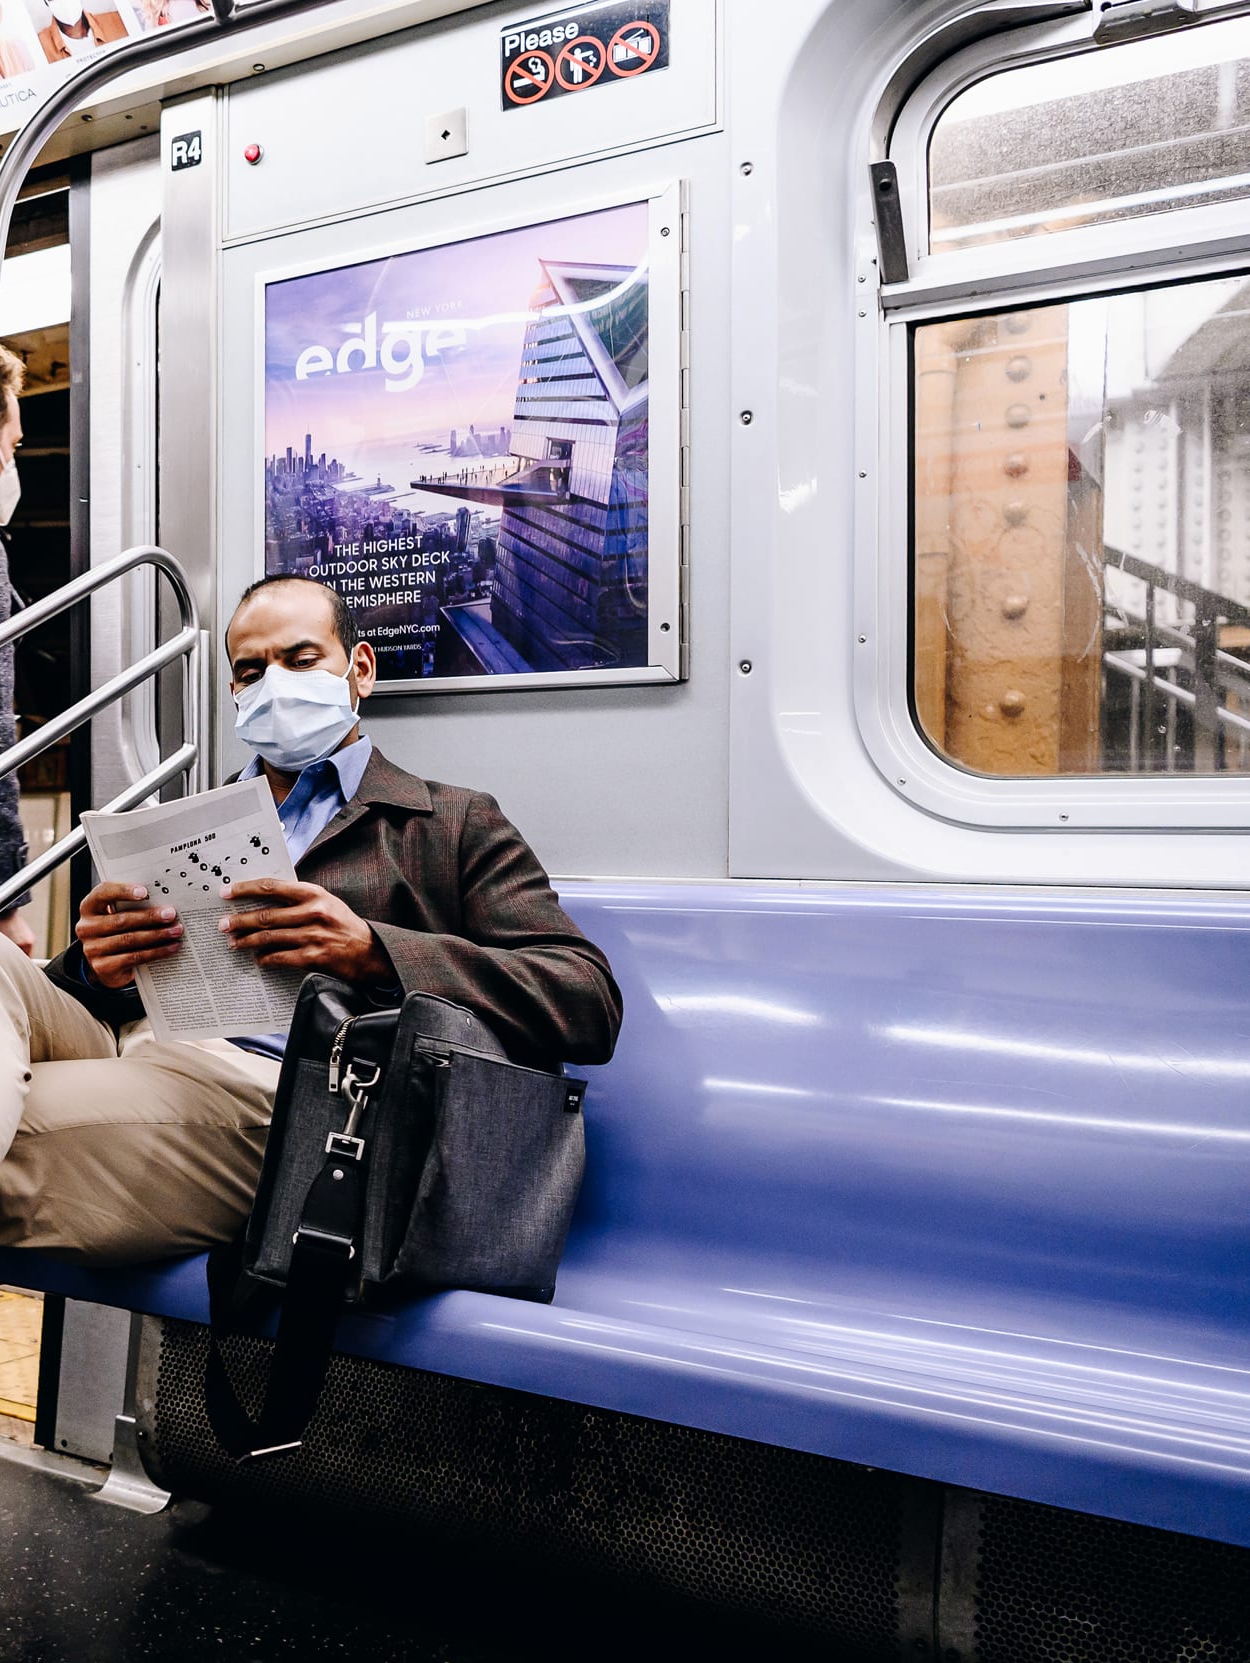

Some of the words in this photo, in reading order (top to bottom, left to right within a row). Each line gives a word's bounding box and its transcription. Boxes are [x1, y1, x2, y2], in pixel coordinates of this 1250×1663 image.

[504, 22, 580, 58] Please
[172, 136, 201, 167] R4
[406, 306, 431, 320] NEW
[435, 300, 464, 313] YORK
[295, 310, 467, 393] edge
[334, 542, 360, 557] THE
[363, 535, 423, 553] HIGHEST
[309, 558, 378, 576] OUTDOOR
[381, 555, 408, 571] SKY
[411, 550, 451, 567] DECK
[340, 577, 366, 592] THE
[368, 570, 437, 589] WESTERN
[343, 590, 422, 609] EMISPHERE
[366, 628, 376, 637] at
[377, 623, 441, 638] EdgeNYC.com
[377, 645, 403, 653] HUDSON
[170, 838, 202, 854] PAMPLONA
[204, 832, 216, 843] 500
